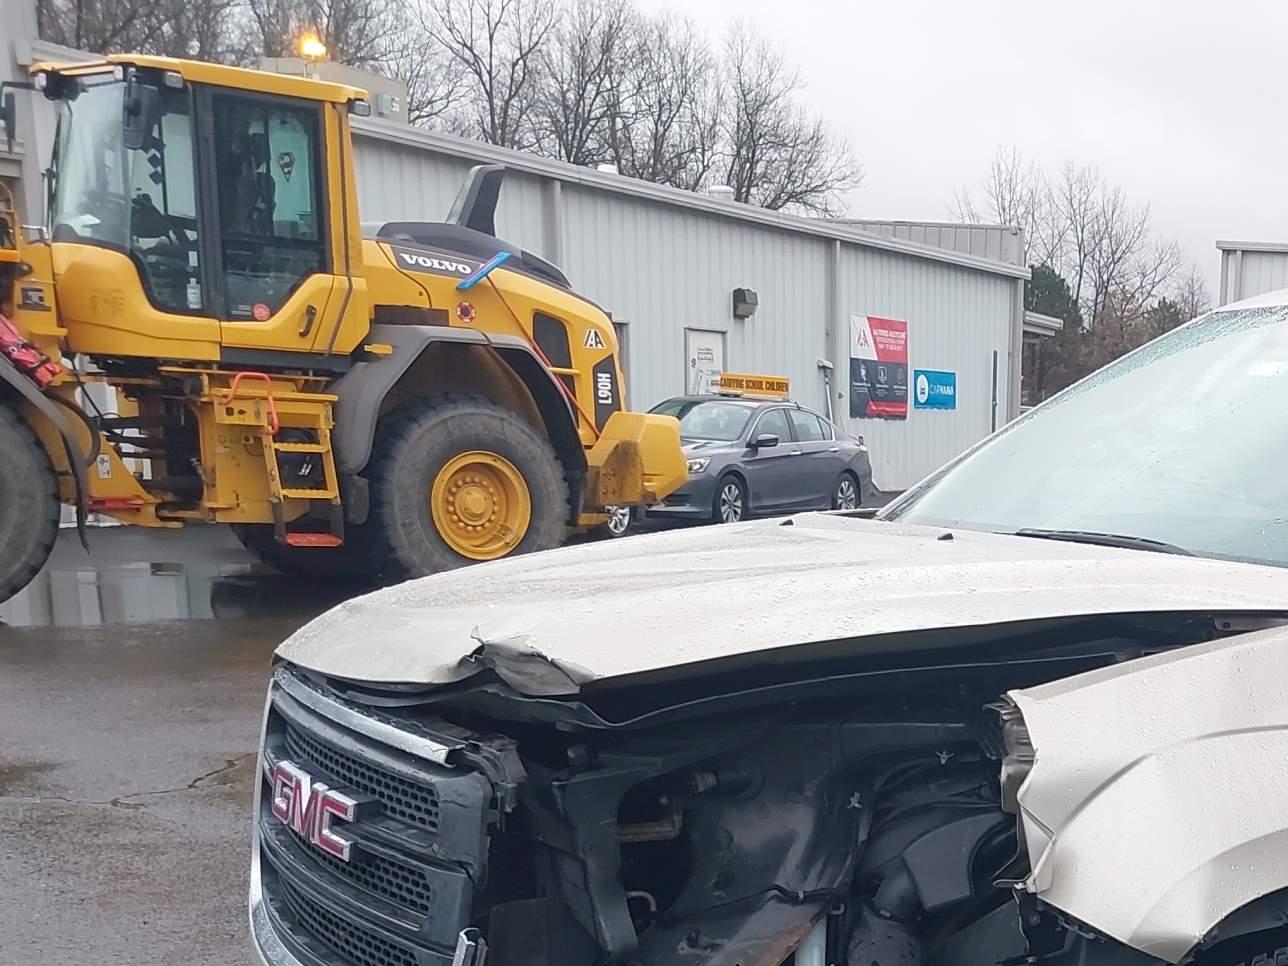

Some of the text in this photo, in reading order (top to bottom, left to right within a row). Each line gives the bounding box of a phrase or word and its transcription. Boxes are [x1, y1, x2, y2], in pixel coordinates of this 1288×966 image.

[400, 253, 472, 275] VOLVO
[597, 372, 613, 405] L90H
[271, 760, 358, 862] GMC
